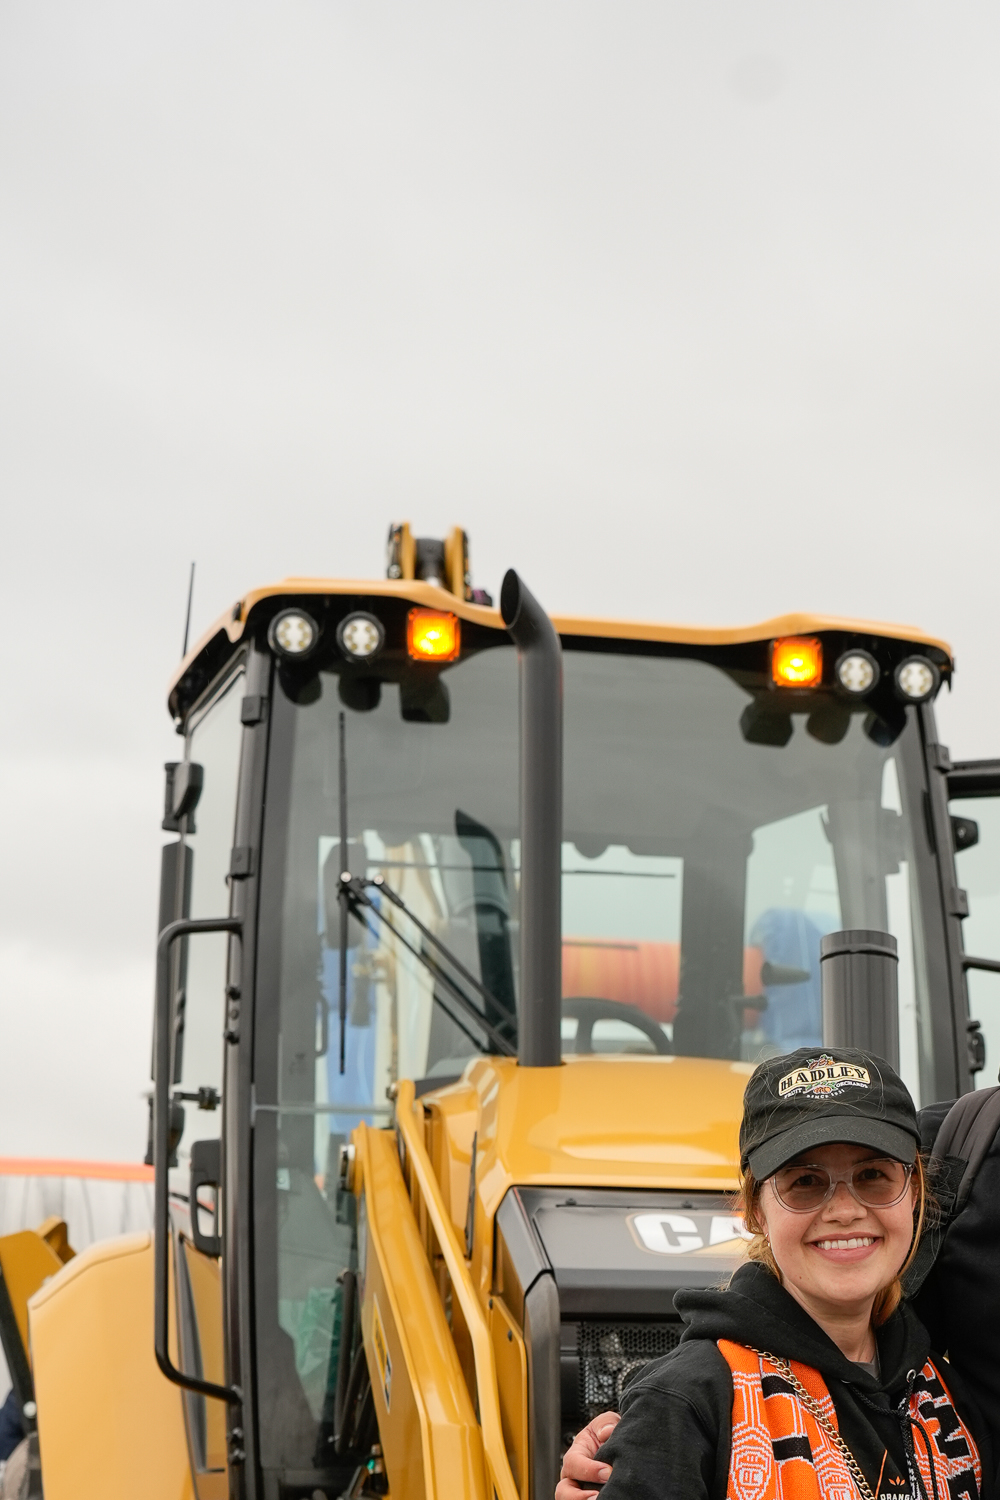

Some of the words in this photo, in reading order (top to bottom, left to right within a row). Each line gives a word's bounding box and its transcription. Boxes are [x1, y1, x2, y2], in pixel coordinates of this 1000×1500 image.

[781, 1067, 866, 1091] HADLEY
[784, 1088, 802, 1099] FRUIT
[634, 1213, 756, 1254] CA
